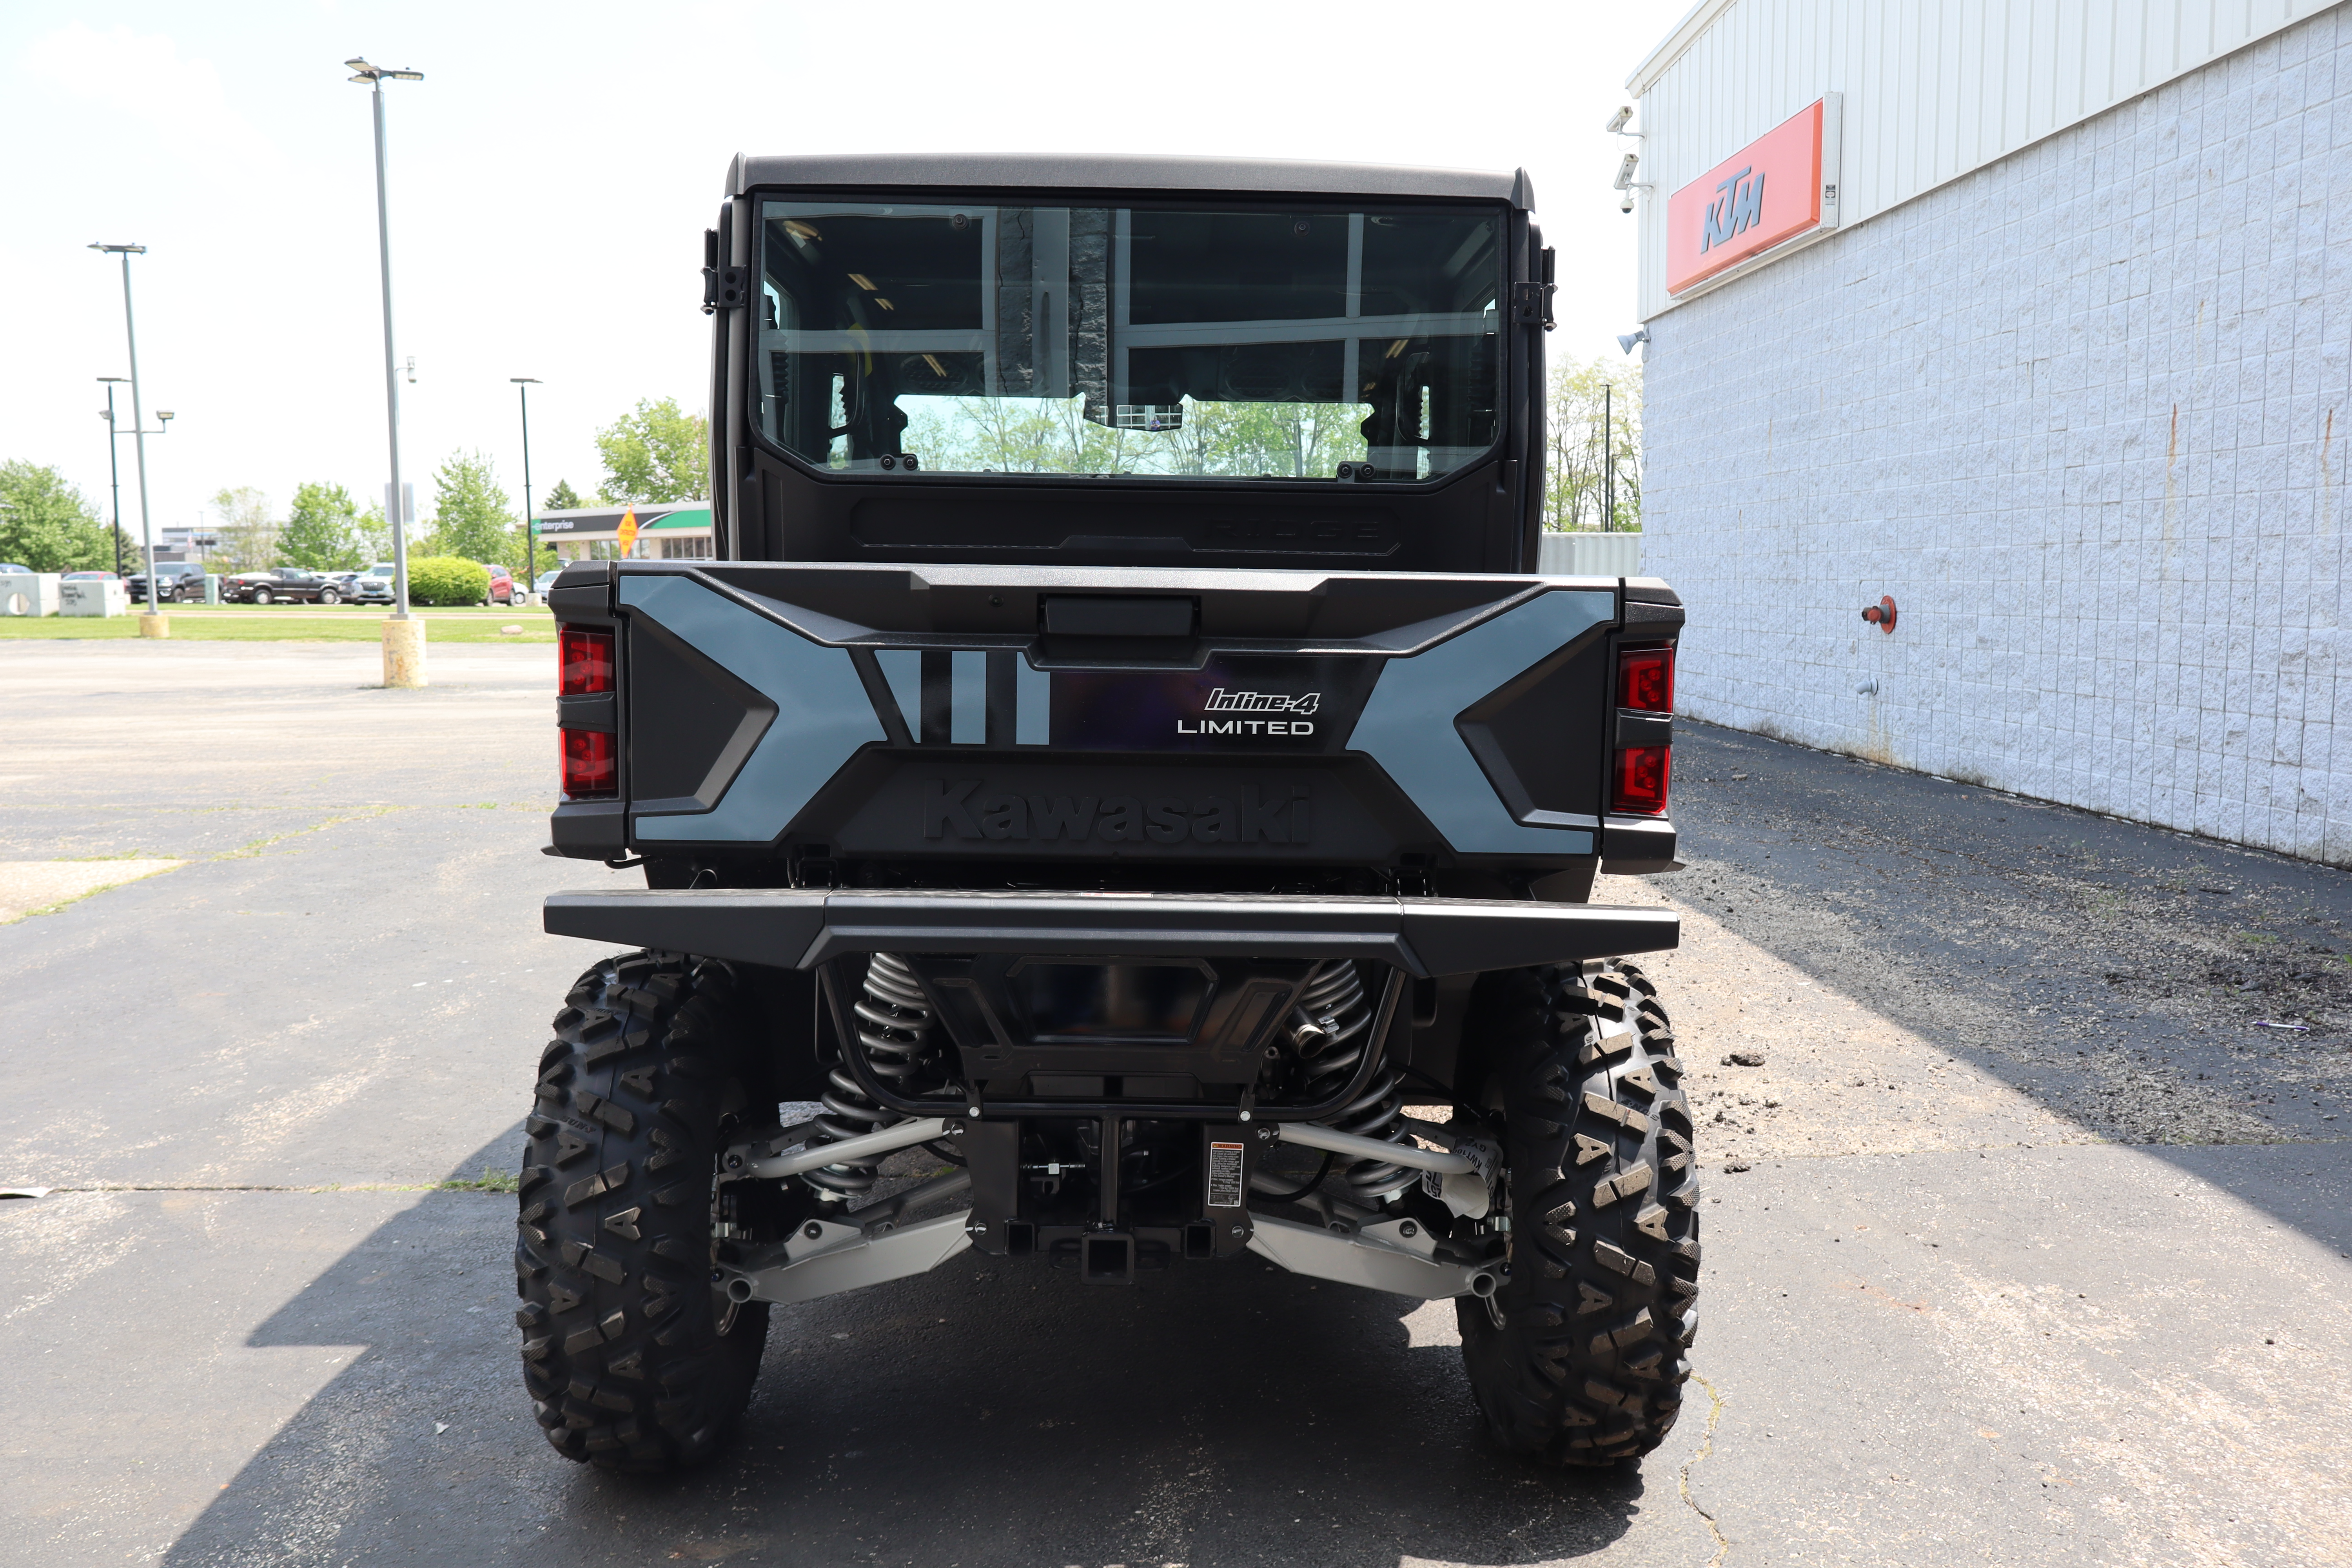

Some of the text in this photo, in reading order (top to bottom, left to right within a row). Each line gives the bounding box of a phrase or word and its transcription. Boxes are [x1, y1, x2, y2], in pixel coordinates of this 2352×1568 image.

[1700, 165, 1765, 255] KTM
[535, 519, 574, 532] enterprise
[1204, 517, 1379, 539] RIDGE
[1204, 688, 1321, 715] Inline-4
[1178, 720, 1314, 735] LIMITED
[924, 779, 1310, 843] Kawasaki
